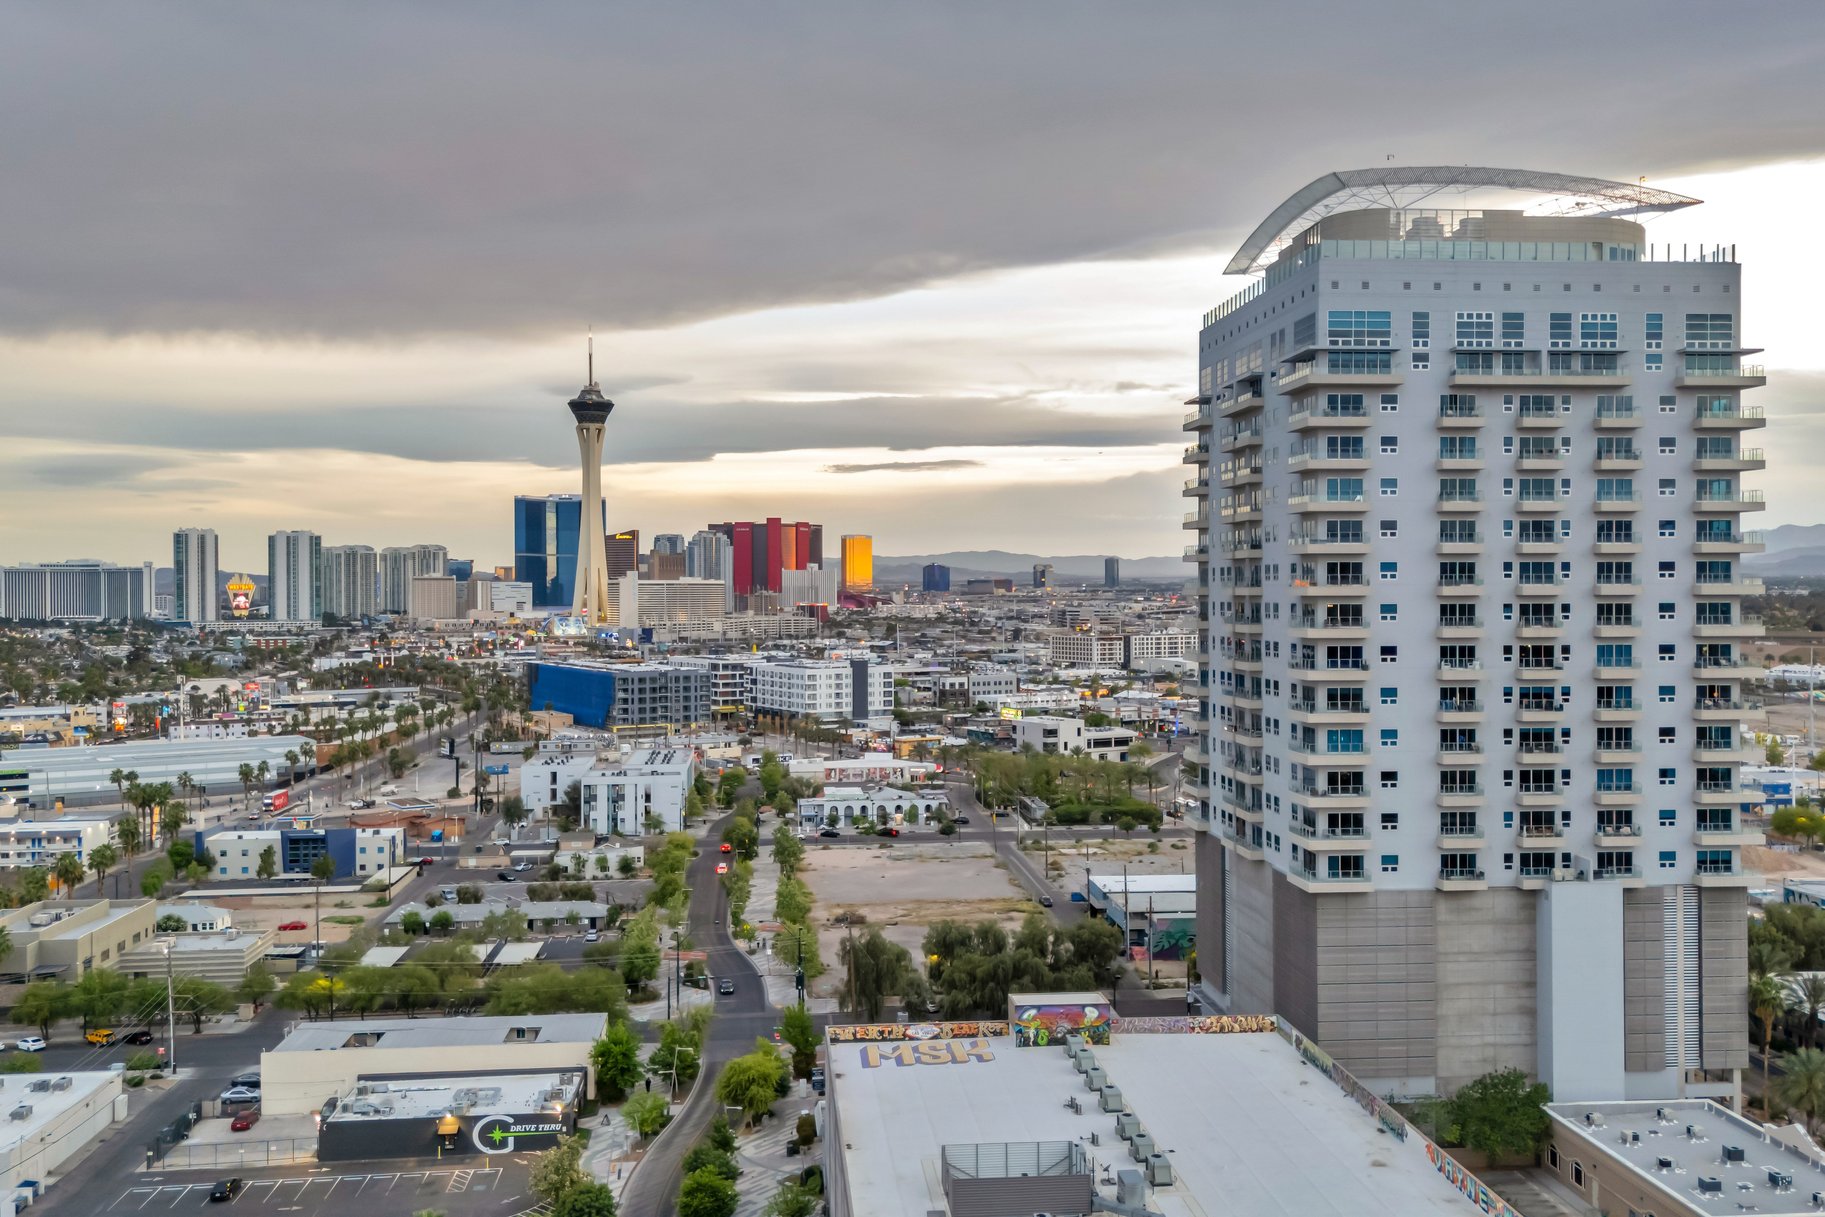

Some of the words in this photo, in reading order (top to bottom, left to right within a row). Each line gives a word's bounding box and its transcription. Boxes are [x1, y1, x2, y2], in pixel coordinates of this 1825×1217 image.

[860, 1040, 996, 1069] MSK
[472, 1114, 515, 1154] G
[510, 1124, 537, 1132] DRIVE
[538, 1123, 562, 1131] THRU
